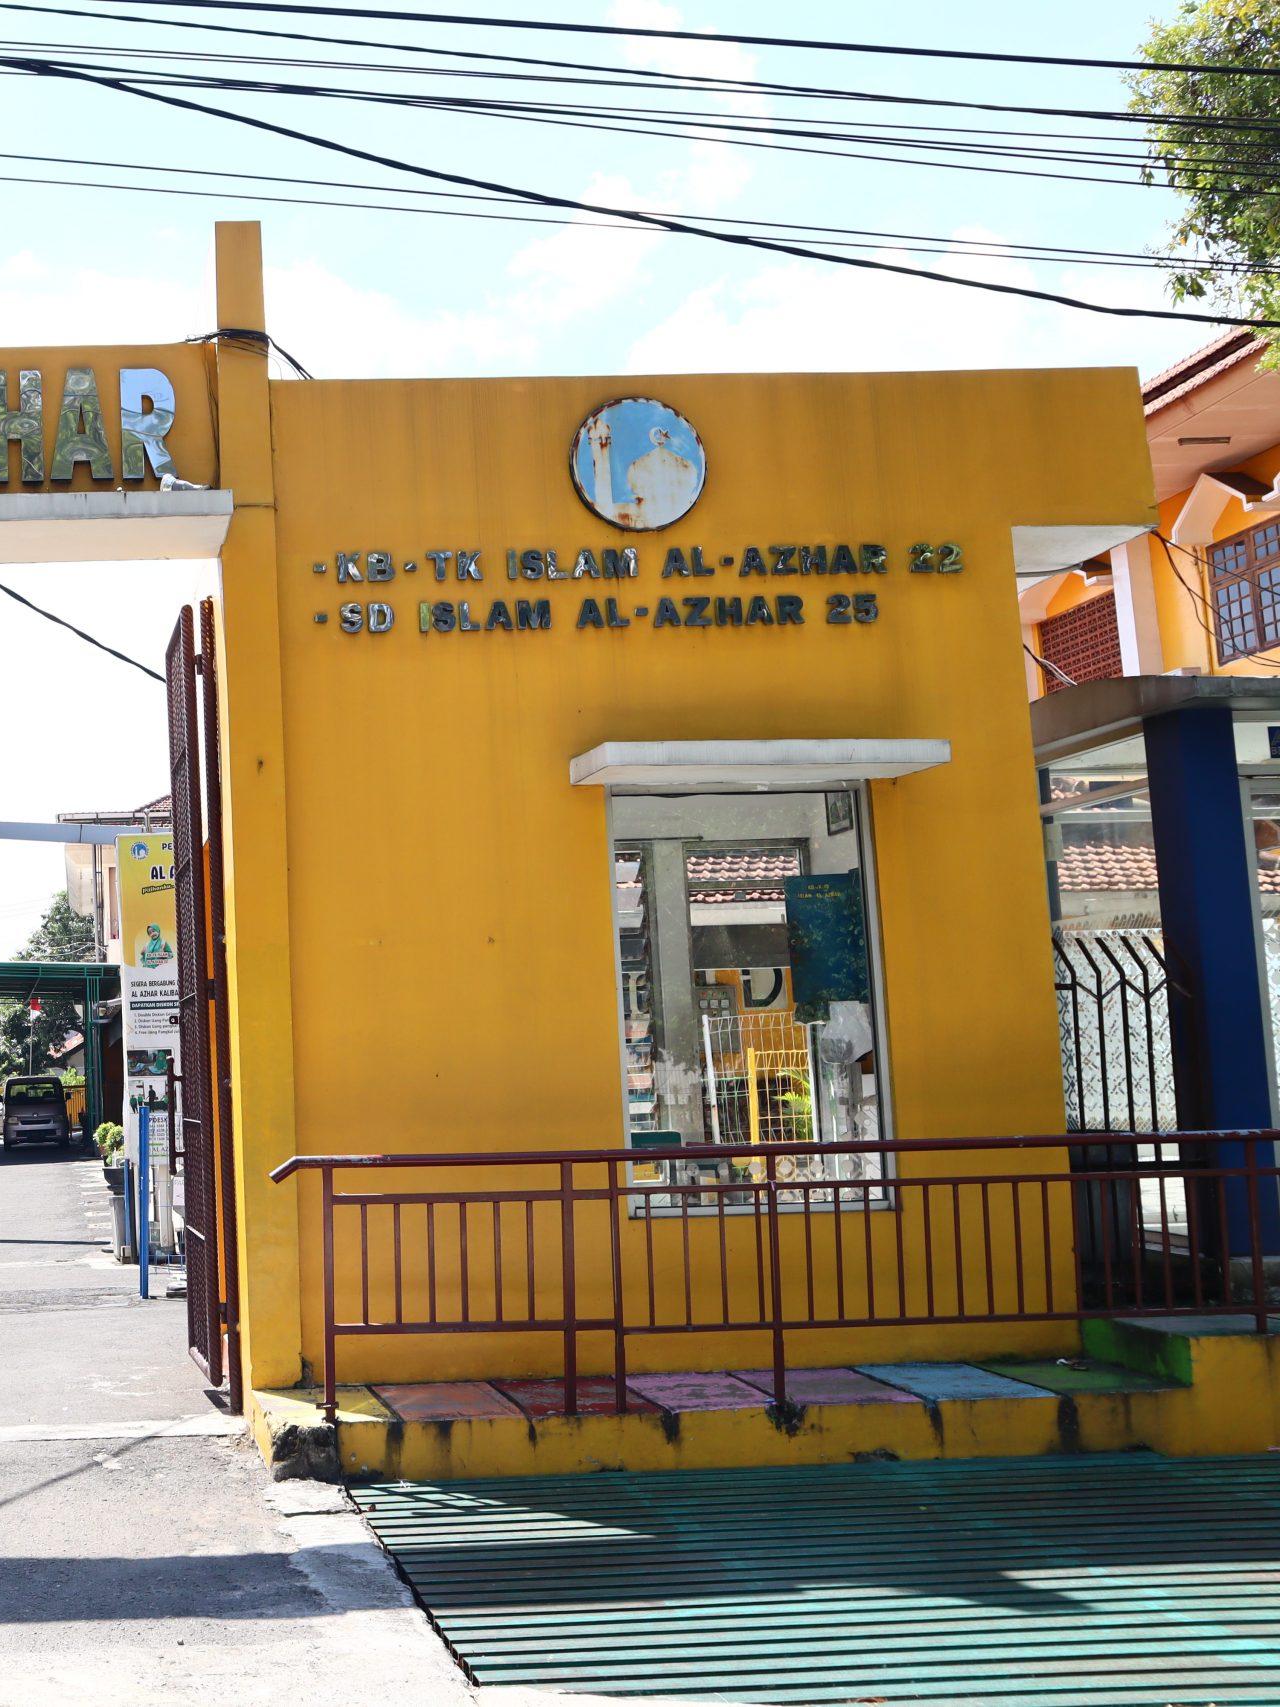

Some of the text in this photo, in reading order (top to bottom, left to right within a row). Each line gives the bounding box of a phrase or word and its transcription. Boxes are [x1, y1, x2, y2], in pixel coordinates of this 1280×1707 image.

[507, 548, 638, 580] ISLAM
[662, 544, 888, 578] AL-AZHAR
[909, 544, 964, 574] 22
[419, 600, 552, 632] ISLAM
[577, 595, 805, 630] AL-AZHAR
[826, 593, 880, 624] 25
[151, 865, 166, 880] AL
[130, 979, 176, 988] SEGERA BERGABUNG
[131, 990, 140, 998] AL
[140, 989, 158, 998] AZHAR
